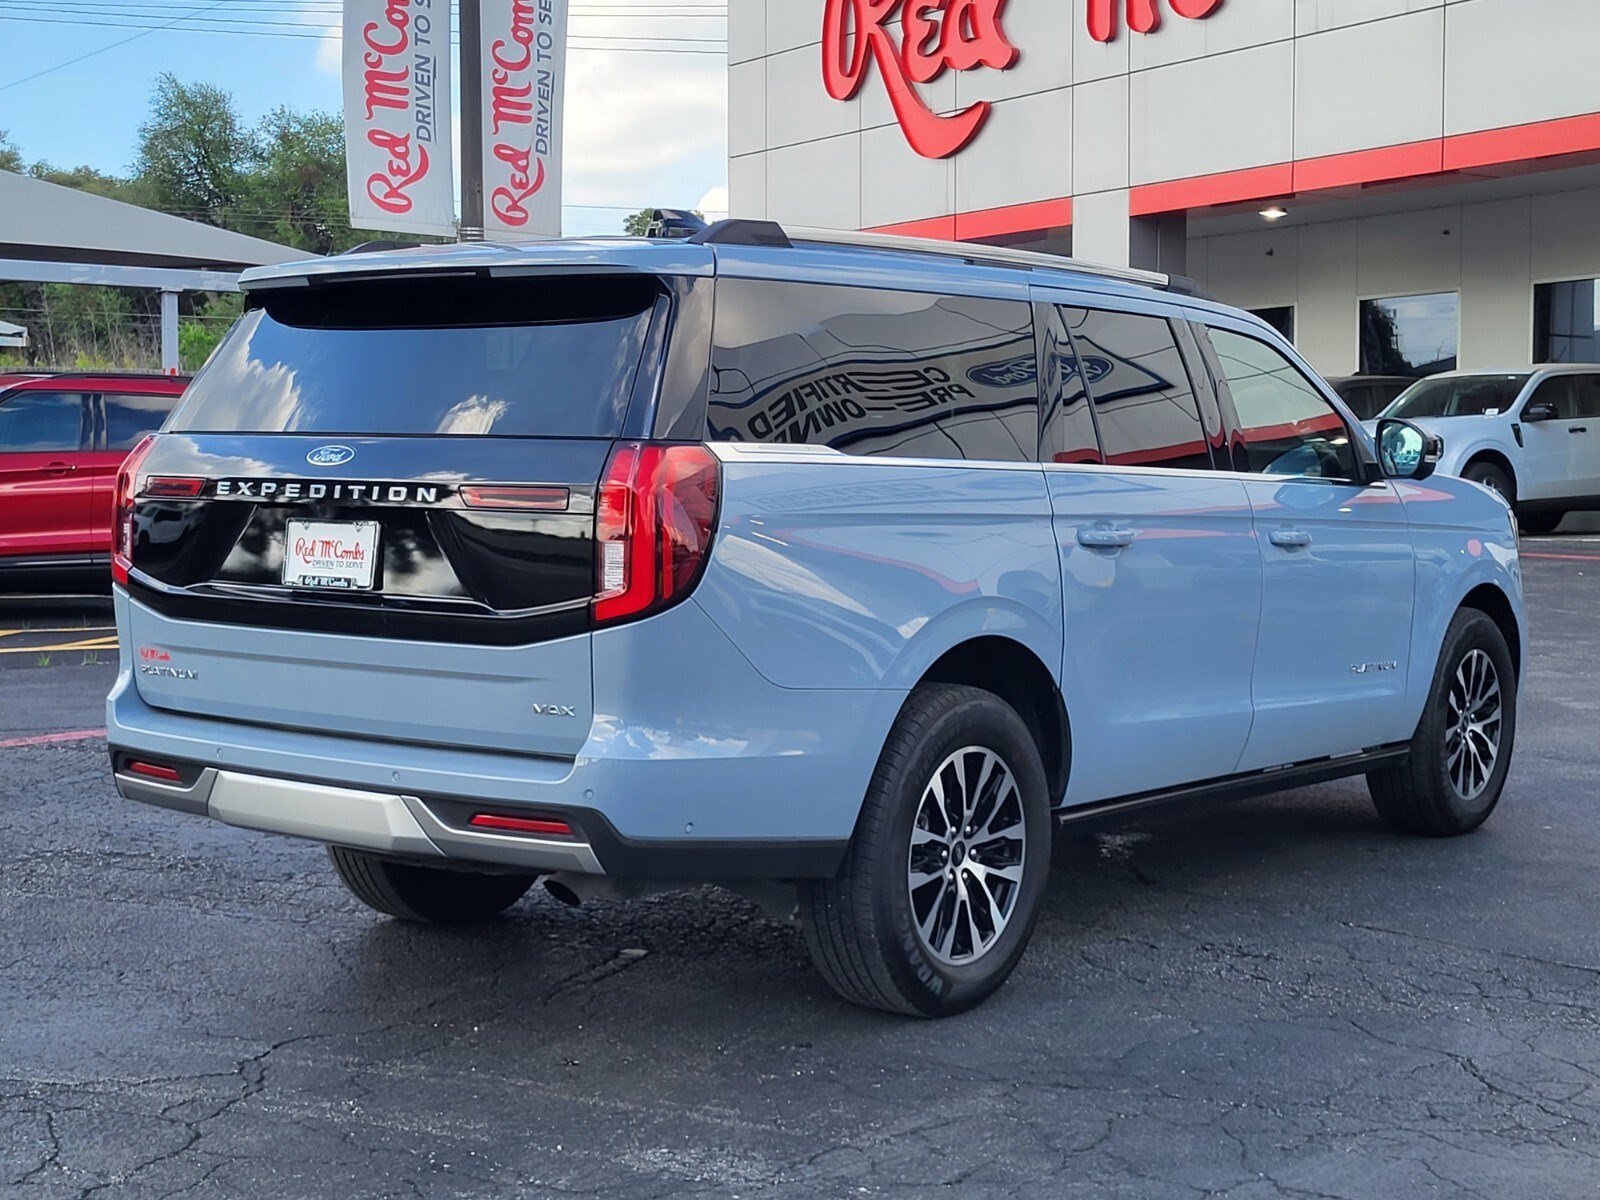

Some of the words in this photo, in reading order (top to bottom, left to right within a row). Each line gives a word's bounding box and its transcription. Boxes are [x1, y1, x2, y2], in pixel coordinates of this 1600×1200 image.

[414, 15, 431, 46] TO
[536, 32, 553, 63] TO
[415, 55, 432, 143] DRIVEN
[536, 70, 551, 155] DRIVEN
[366, 129, 429, 214] Red
[491, 143, 545, 226] Red
[311, 447, 350, 464] Ford
[216, 481, 437, 502] EXPEDITION
[295, 538, 316, 564] Red
[319, 540, 364, 560] McCombs
[336, 560, 344, 568] TO
[345, 561, 364, 569] SERVE
